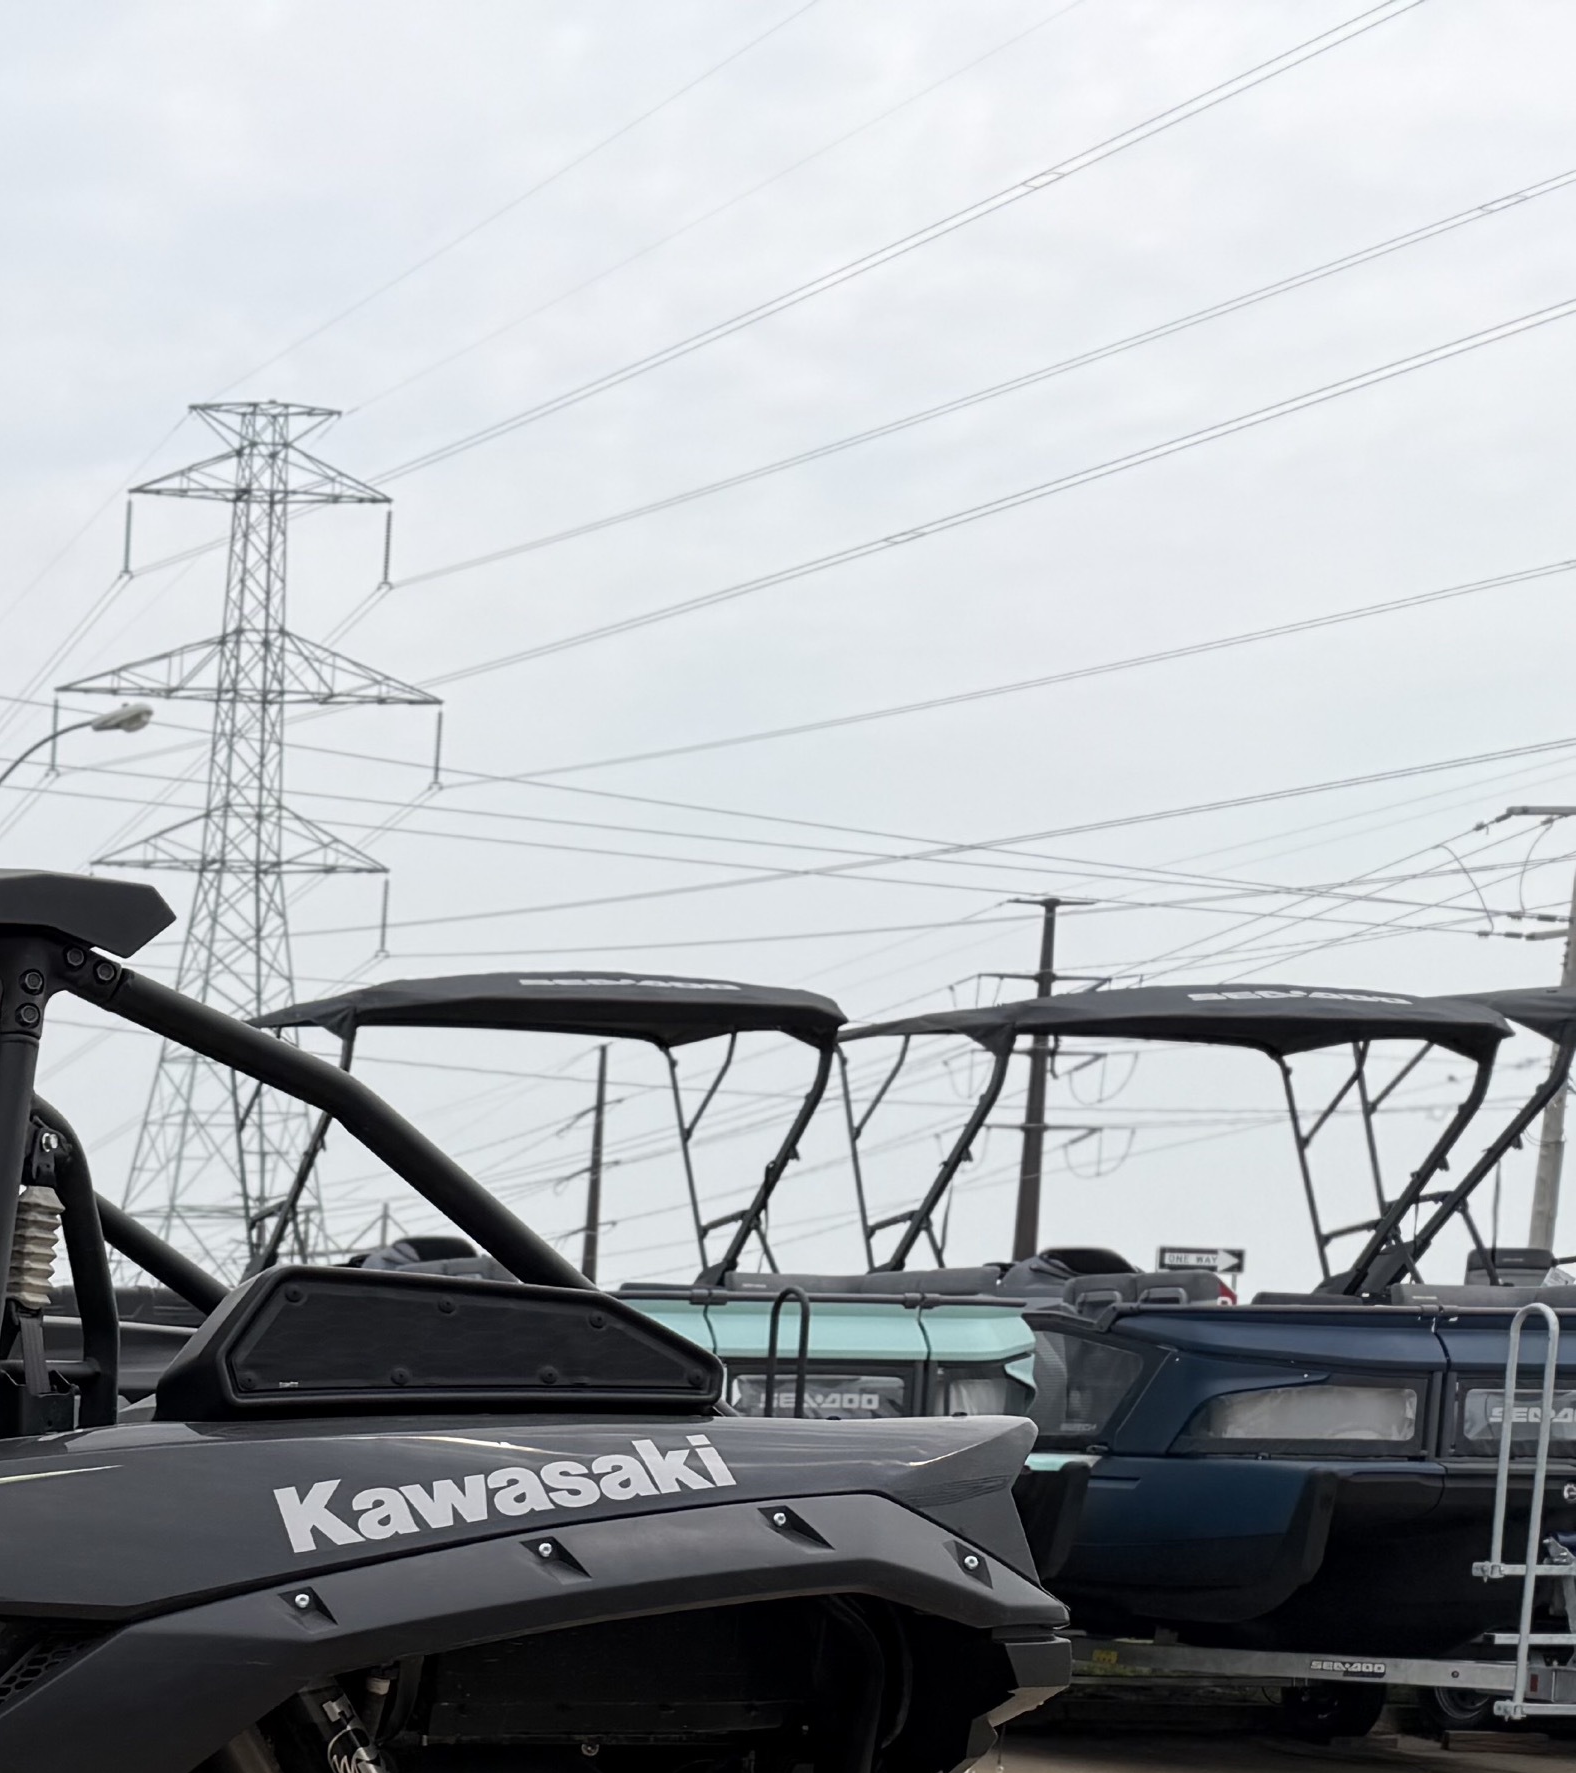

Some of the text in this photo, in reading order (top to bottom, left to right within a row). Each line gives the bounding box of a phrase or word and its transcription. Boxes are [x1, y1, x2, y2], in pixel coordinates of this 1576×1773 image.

[1168, 1254, 1218, 1265] ONE WAY
[273, 1434, 735, 1553] Kawasaki
